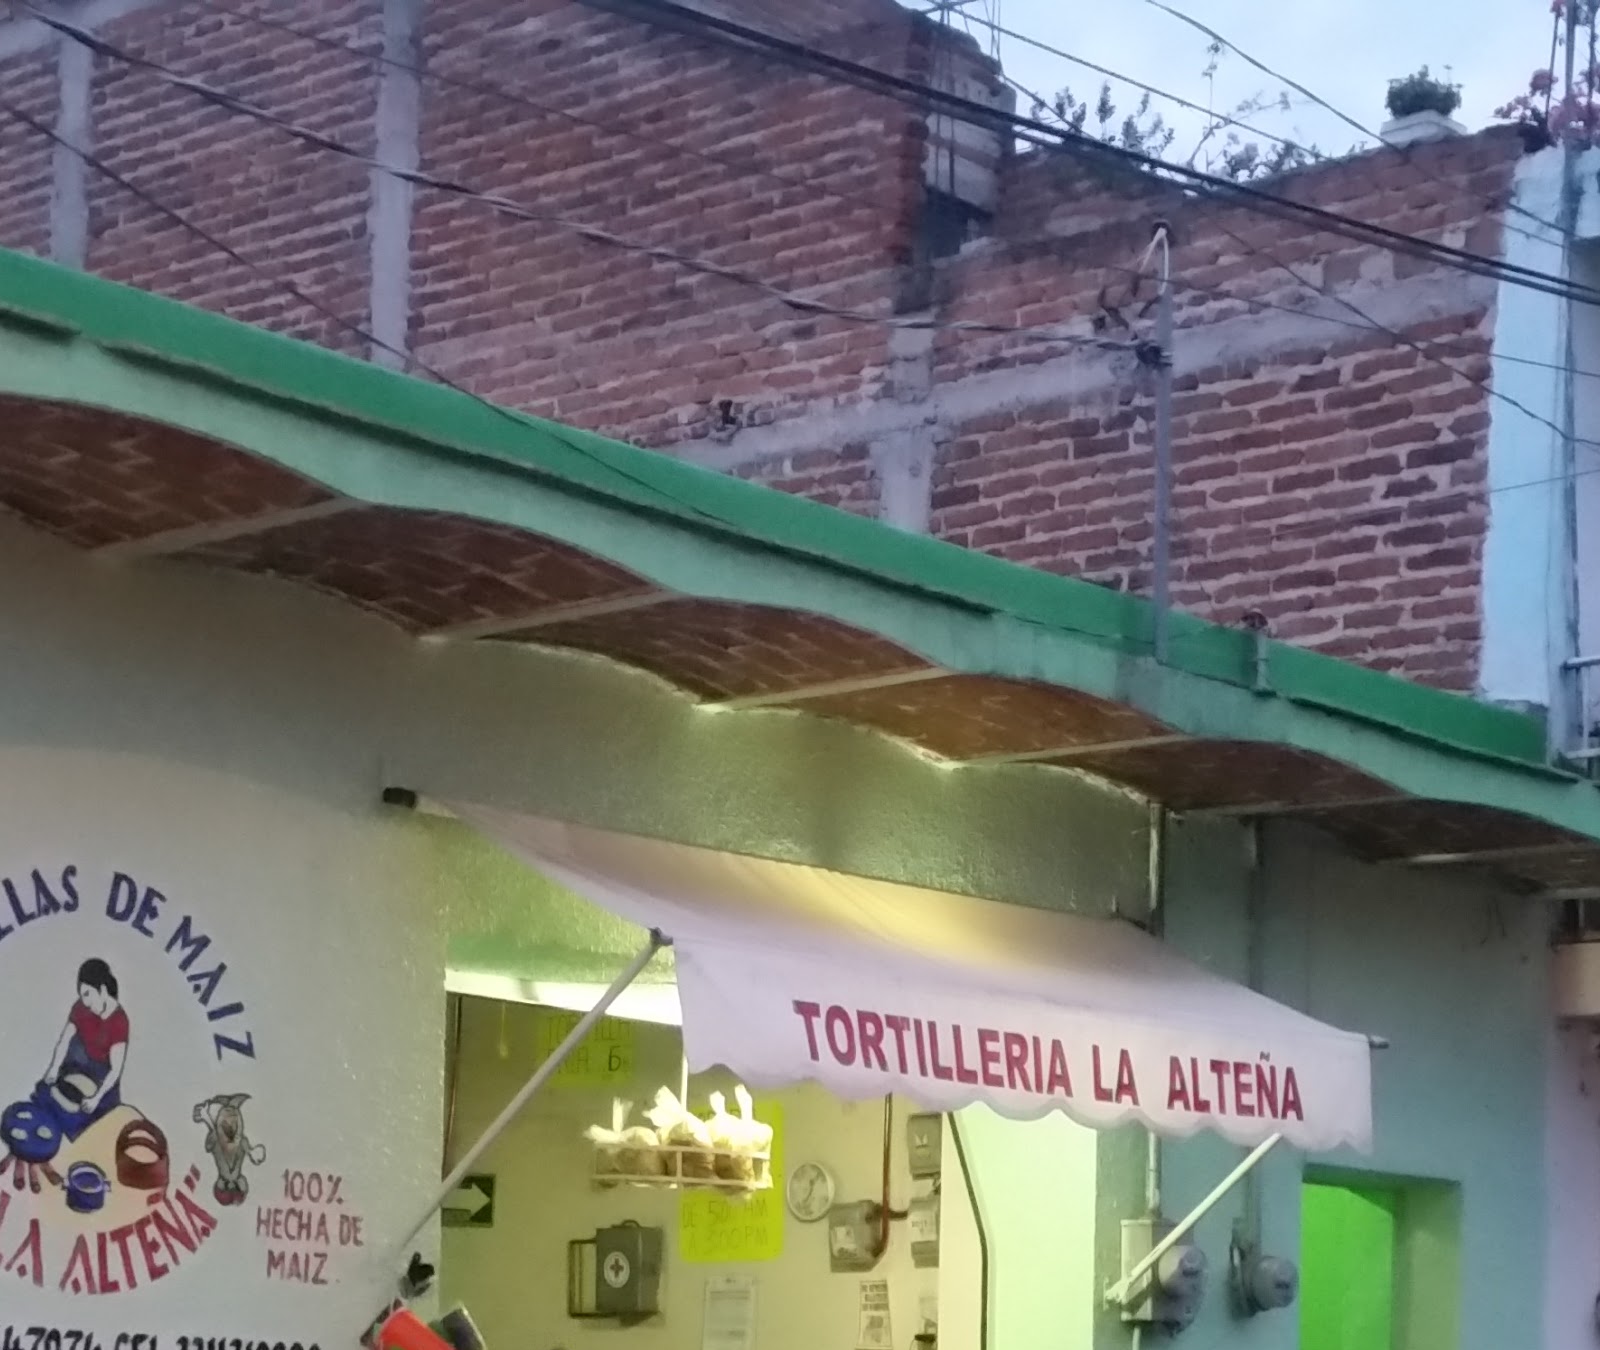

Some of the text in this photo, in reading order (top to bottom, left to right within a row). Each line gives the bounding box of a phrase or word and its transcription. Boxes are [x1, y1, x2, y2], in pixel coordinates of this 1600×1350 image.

[106, 871, 167, 938] DE
[165, 915, 255, 1060] MAIZ
[793, 999, 1304, 1121] TORTILLERIA LA ALTEÑA
[256, 1207, 364, 1247] HECHA DE
[283, 1168, 344, 1205] 100%
